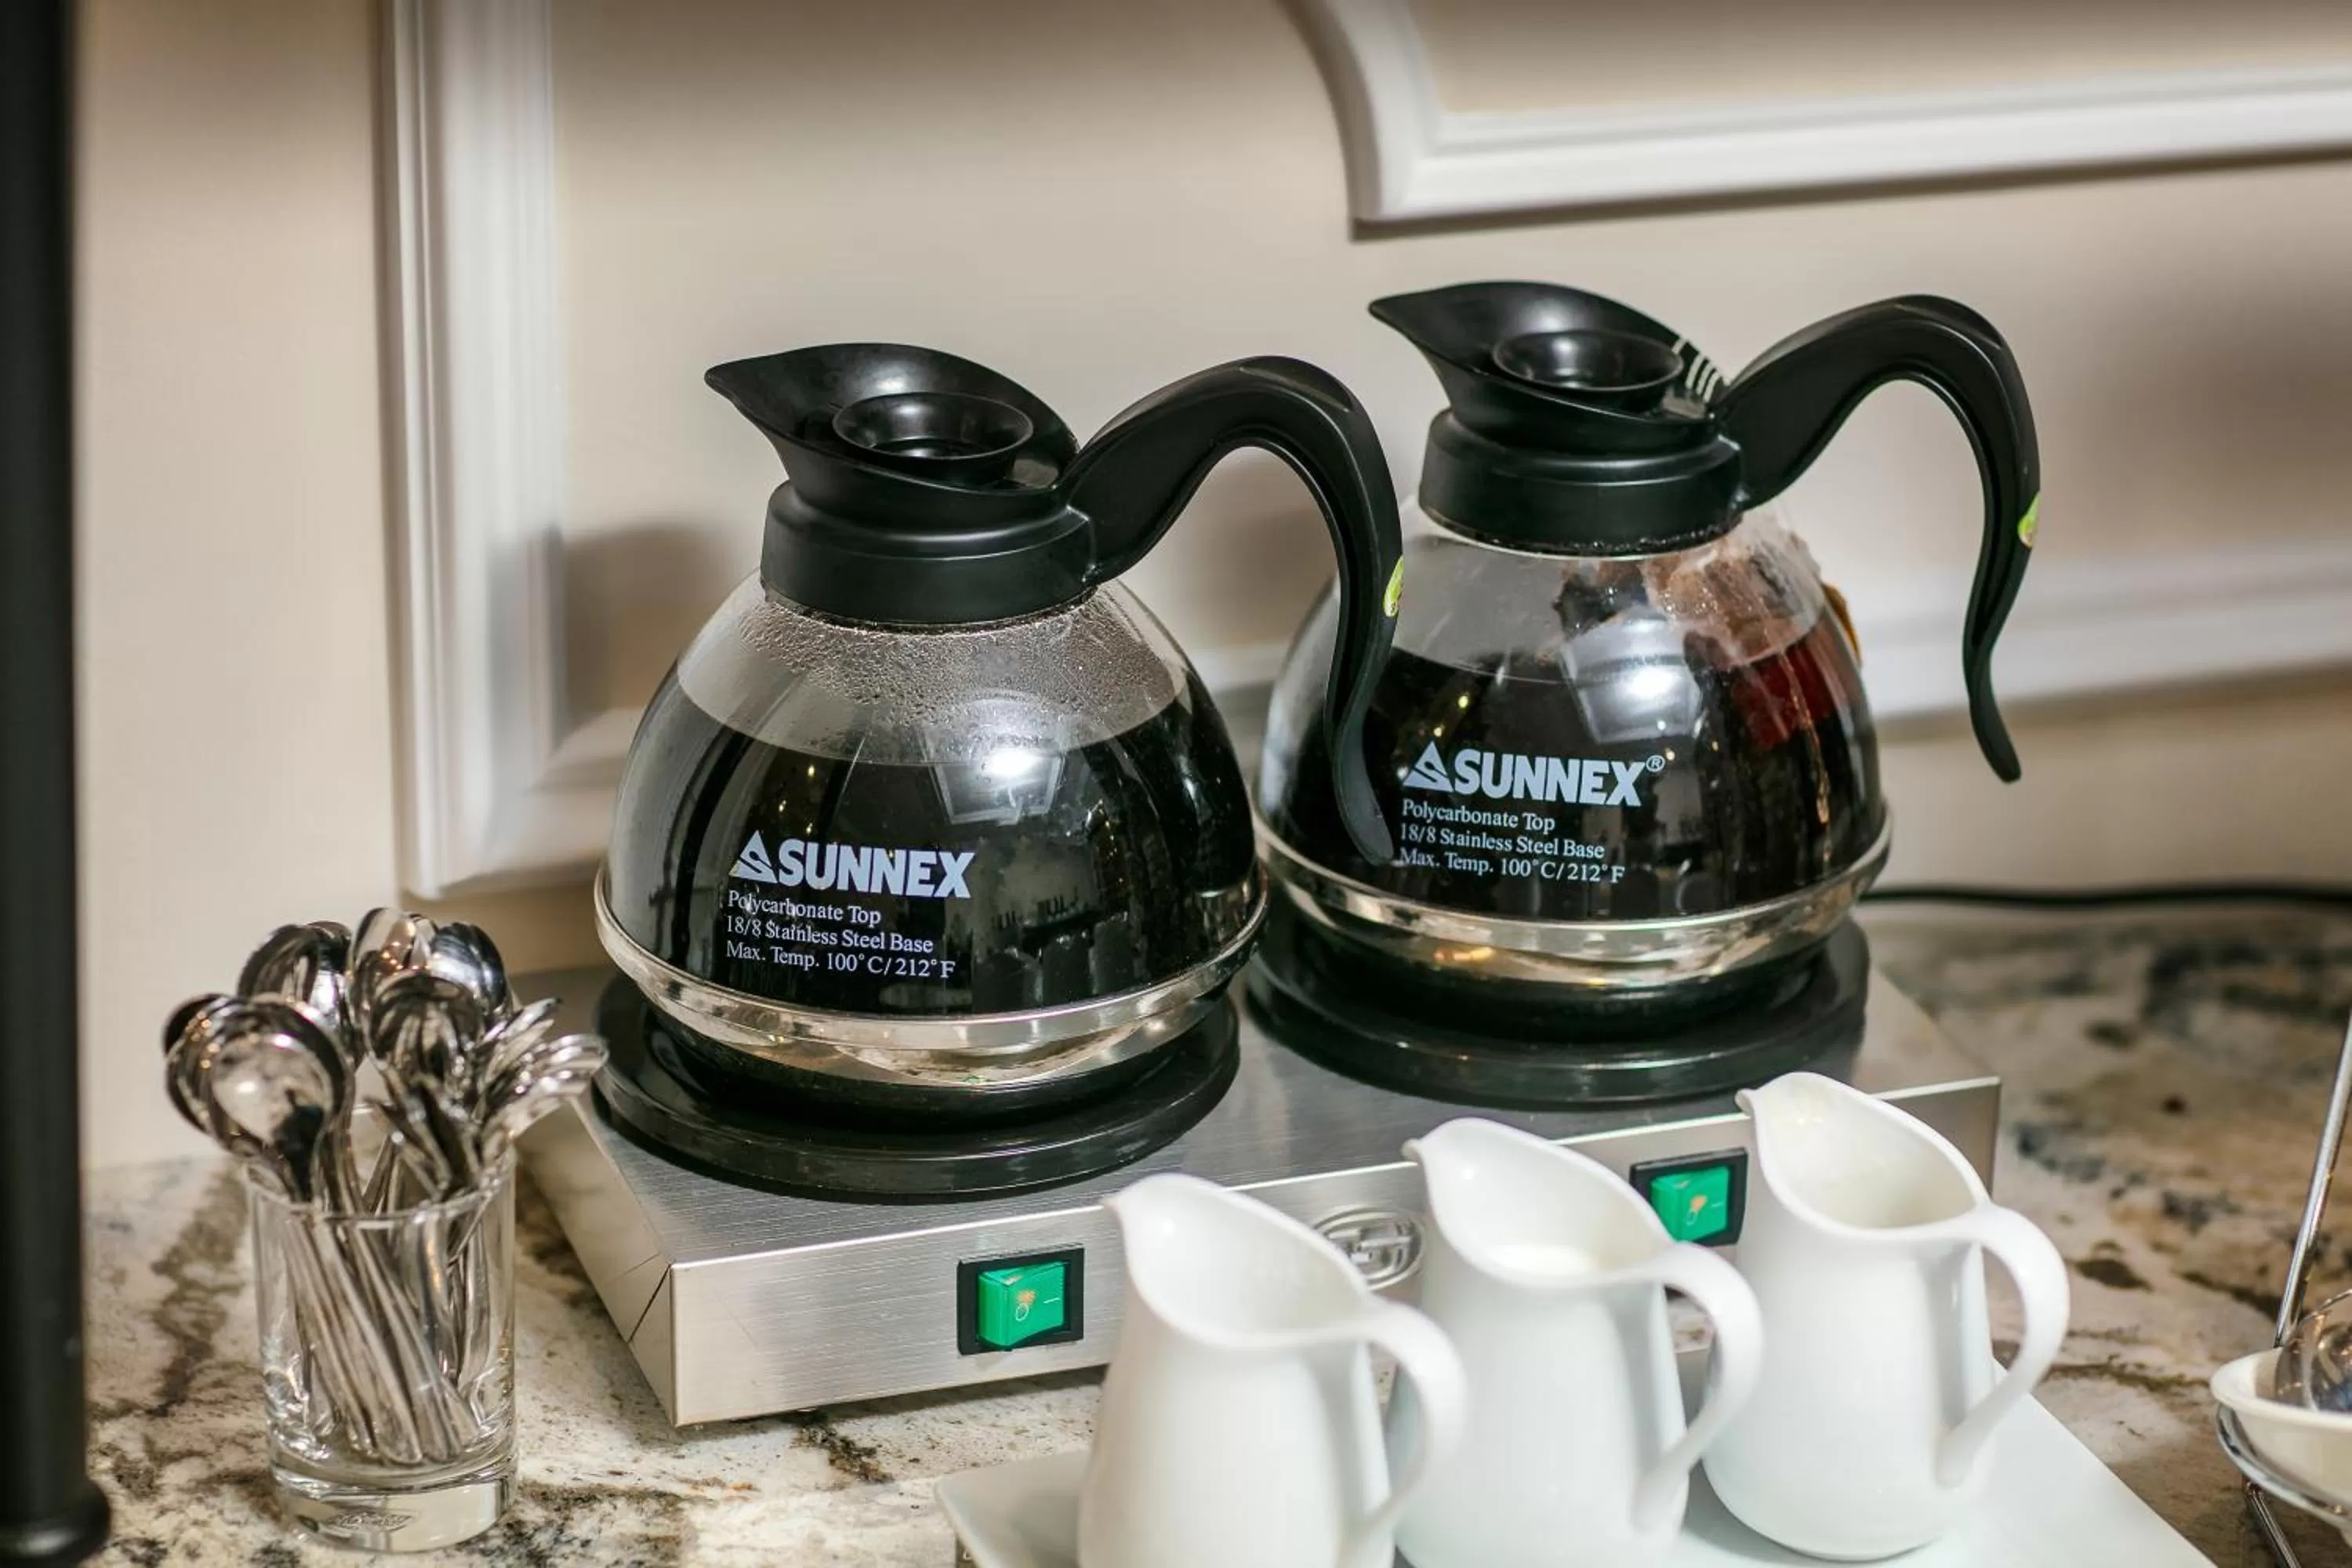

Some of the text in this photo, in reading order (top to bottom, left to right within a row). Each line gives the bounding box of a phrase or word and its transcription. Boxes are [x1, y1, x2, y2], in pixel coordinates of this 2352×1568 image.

[1402, 798, 1555, 835] Polycarbonate Top
[1401, 822, 1605, 859] 18/8 Stainless Steel Base
[779, 838, 976, 899] SUNNEX
[1399, 847, 1440, 867] Max.
[1444, 851, 1494, 877] Temp.
[728, 890, 881, 928] Polycarbonate Top
[728, 915, 934, 953] 18/8 Stainless Steel Base
[726, 941, 766, 960] Max.
[770, 946, 819, 971] Temp.
